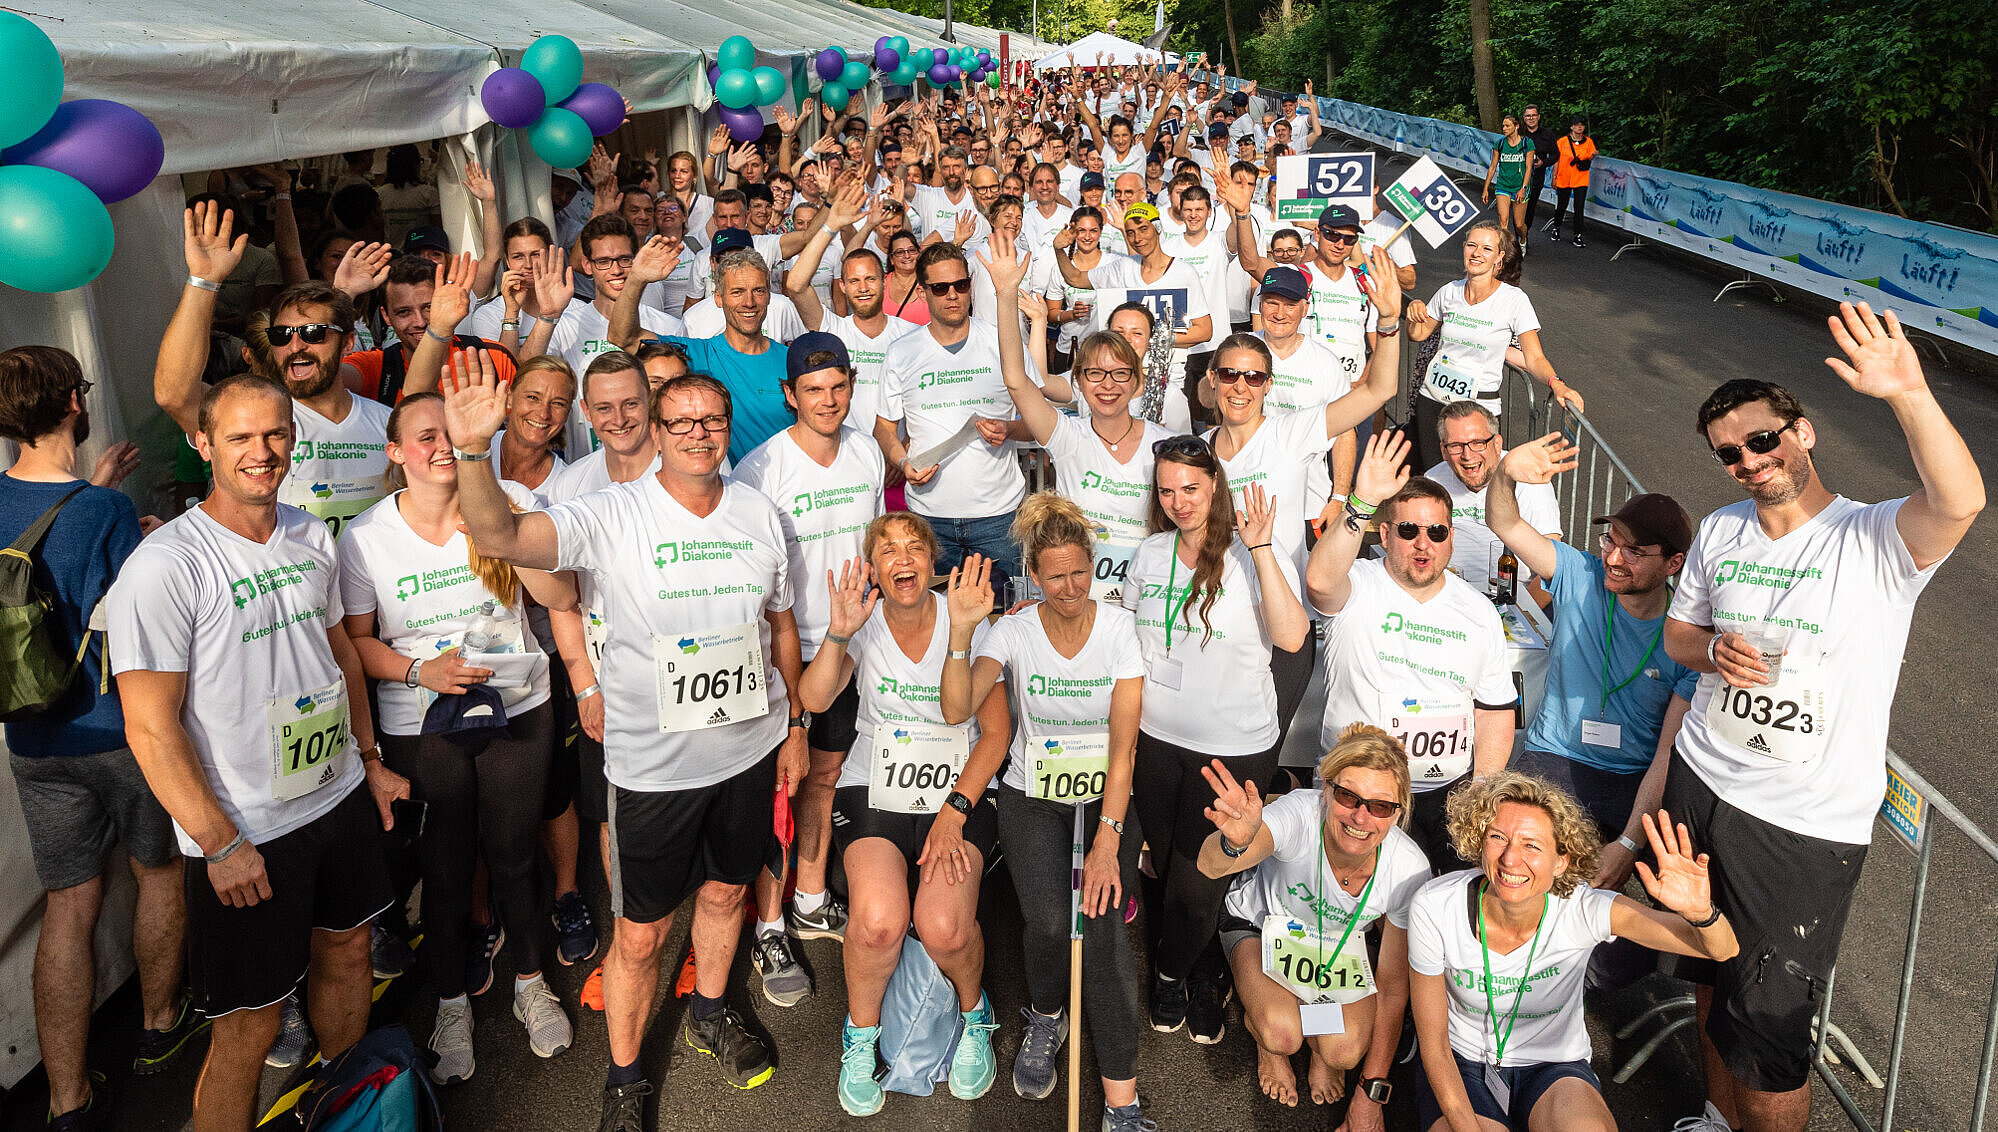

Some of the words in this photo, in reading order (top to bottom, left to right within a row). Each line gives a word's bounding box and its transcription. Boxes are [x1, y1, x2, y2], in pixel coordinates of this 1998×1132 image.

[1315, 160, 1364, 195] 52
[1425, 185, 1466, 225] 39
[1748, 214, 1788, 242] Läuft!
[1816, 232, 1866, 265] Läuft!
[1901, 253, 1960, 292] Läuft!
[937, 366, 992, 378] Johannesstift
[937, 375, 973, 386] Diakonie
[921, 400, 942, 411] Gutes
[959, 398, 981, 407] Jeden
[317, 441, 386, 452] Johannesstif
[317, 450, 367, 460] Diakonie
[814, 483, 871, 499] Johannesstift
[815, 495, 854, 510] Diakonie
[681, 540, 753, 551] Johannesstift
[682, 550, 733, 562] Diakonie
[422, 564, 470, 582] Johanne
[1737, 572, 1791, 589] Diakonie
[658, 589, 690, 600] Gutes
[691, 588, 711, 597] tun.
[713, 584, 744, 595] Jeden
[746, 583, 765, 596] Tag.
[406, 618, 435, 629] Gutes
[435, 612, 457, 624] tun.
[458, 605, 482, 617] Jede
[1796, 618, 1823, 634] Tag.
[668, 662, 675, 673] D
[1378, 651, 1404, 665] Gutes
[1448, 670, 1468, 685] Tag.
[1048, 676, 1113, 688] Johannesstift
[1048, 687, 1092, 697] Diakonie
[707, 715, 731, 725] adidas
[1071, 718, 1098, 727] Jeden
[1392, 717, 1399, 728] D
[283, 726, 292, 738] D
[882, 748, 889, 758] D
[1747, 741, 1772, 753] adidas
[1036, 760, 1043, 771] D
[1275, 938, 1282, 950] D
